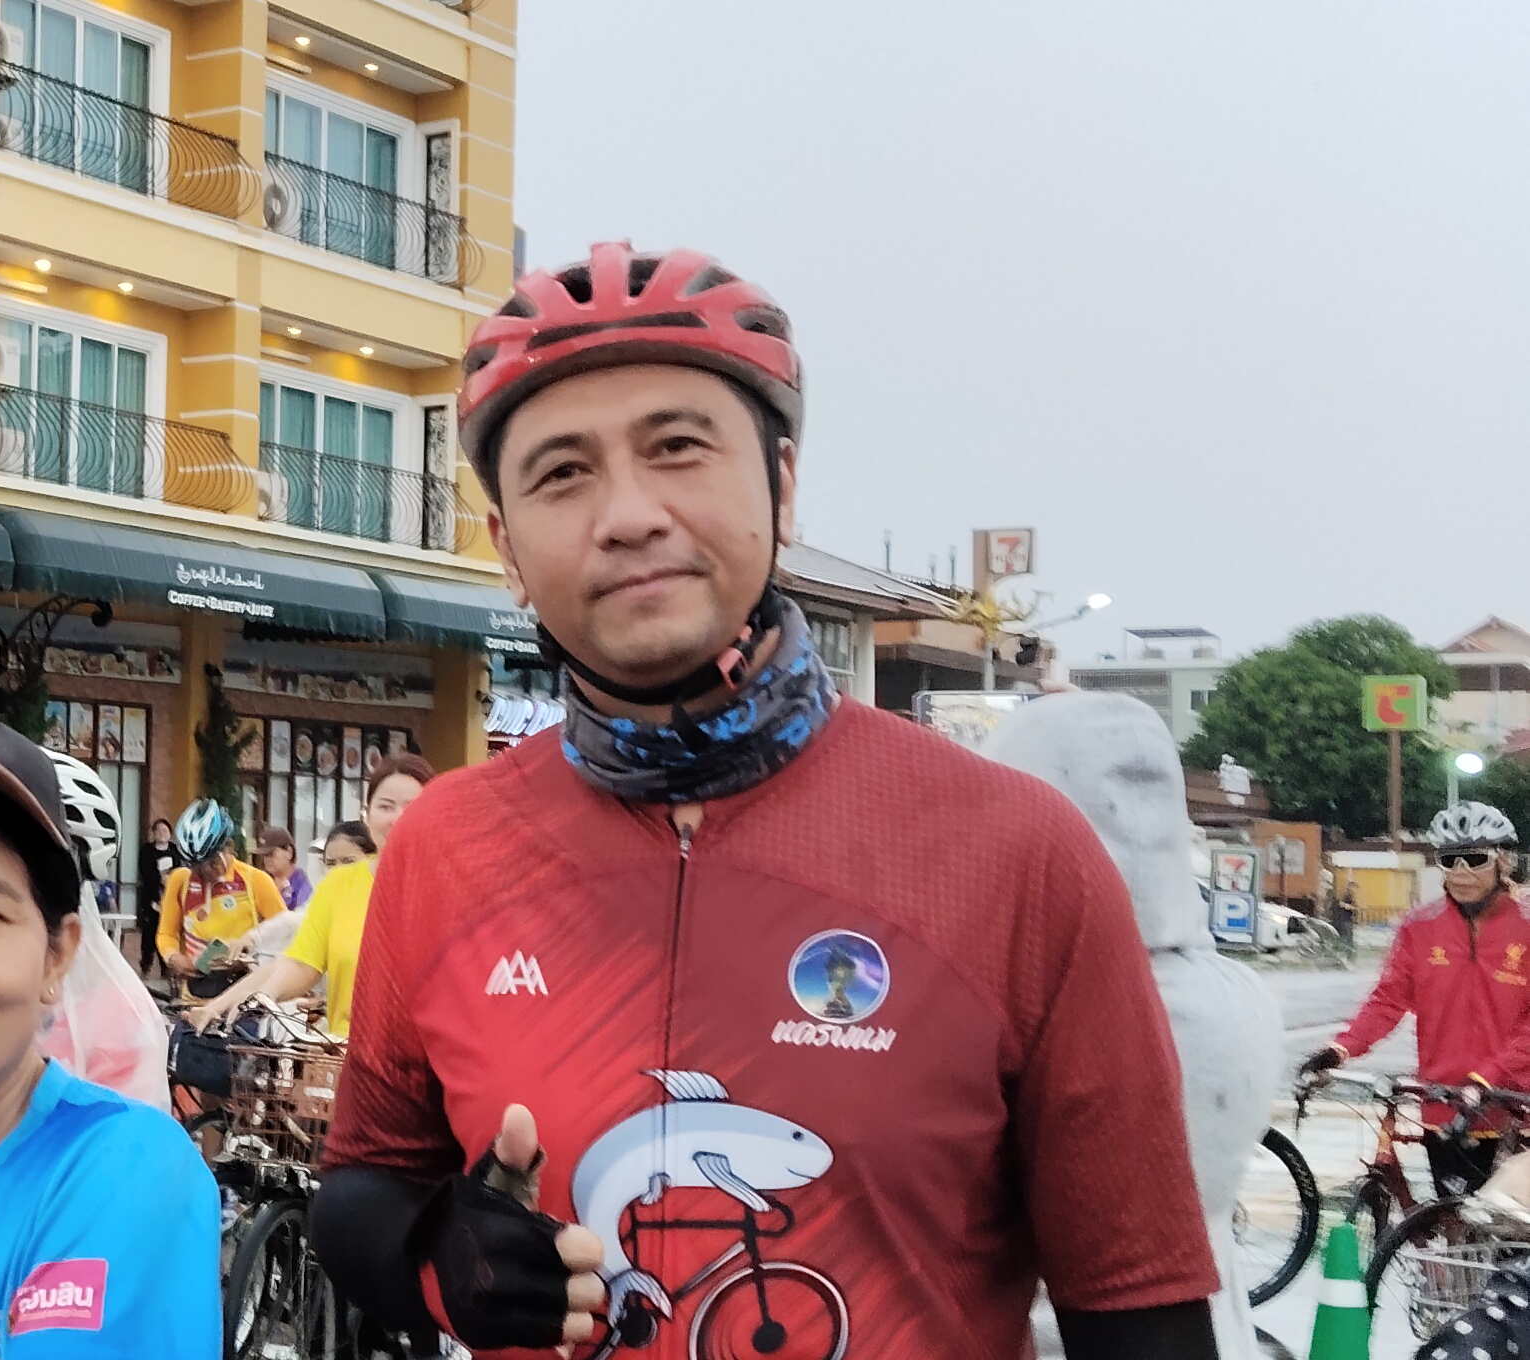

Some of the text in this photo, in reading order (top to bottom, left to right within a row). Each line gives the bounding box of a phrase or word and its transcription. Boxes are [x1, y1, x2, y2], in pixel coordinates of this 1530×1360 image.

[997, 536, 1023, 574] 7
[168, 589, 206, 608] COFFEE
[1219, 897, 1250, 929] P
